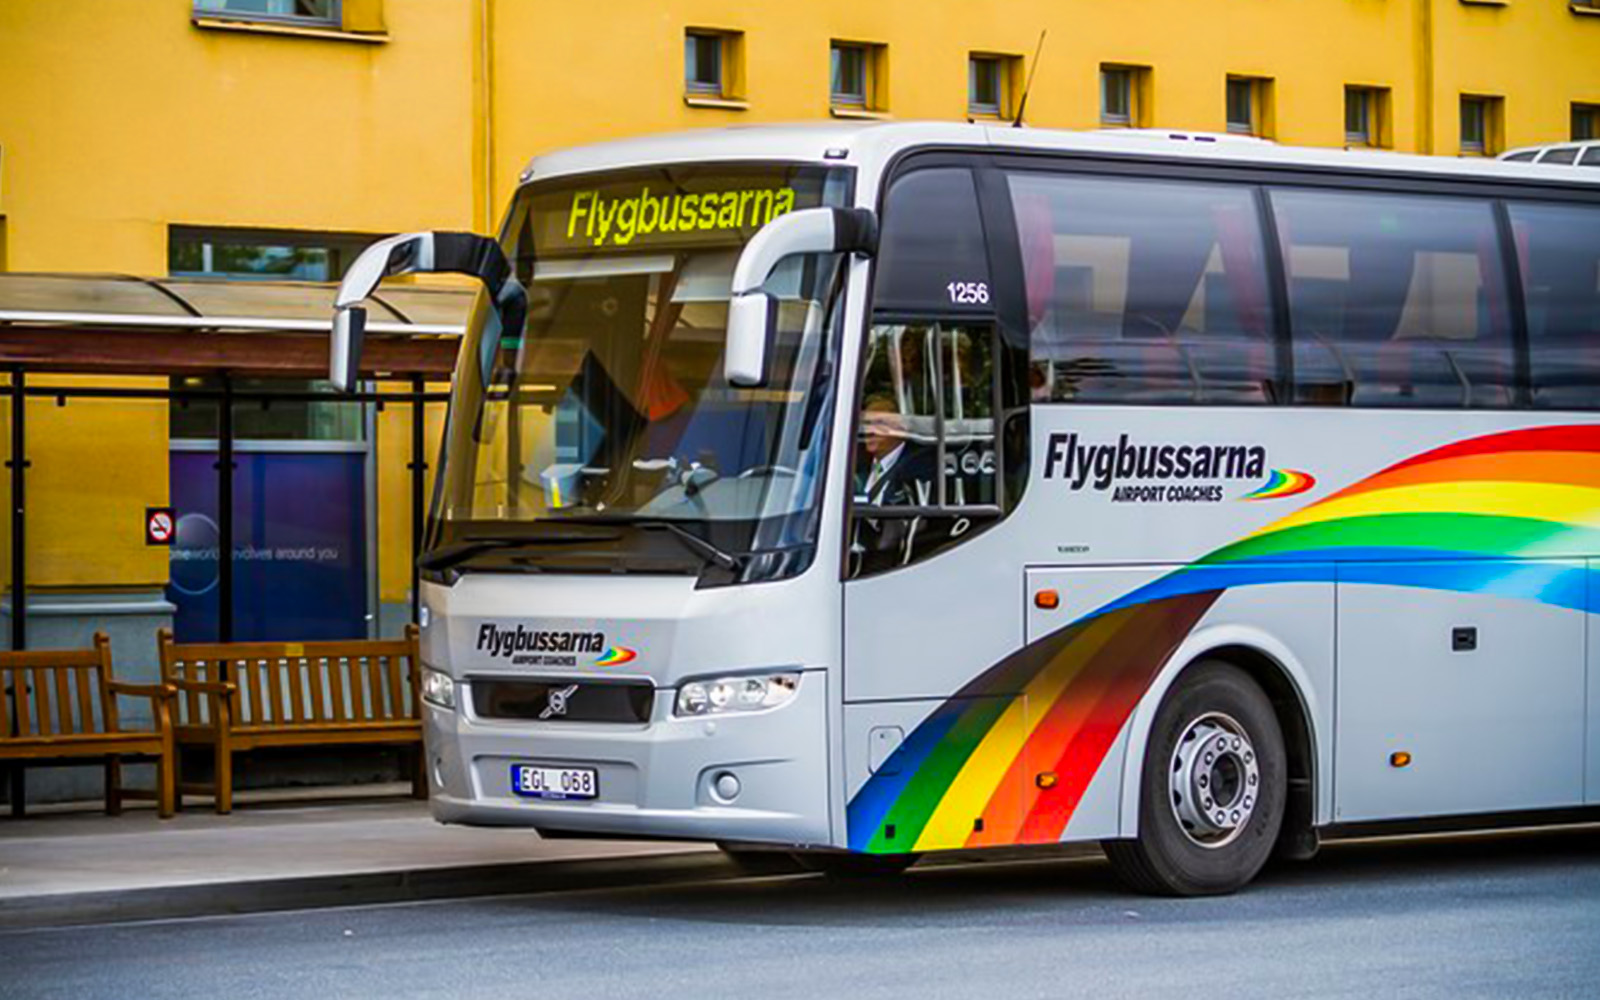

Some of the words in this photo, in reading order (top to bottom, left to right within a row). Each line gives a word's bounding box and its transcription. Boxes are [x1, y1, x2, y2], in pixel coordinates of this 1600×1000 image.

[567, 187, 796, 246] Flygbussarna
[947, 281, 989, 304] 1256
[1043, 432, 1266, 491] Flygbussarna
[1111, 484, 1166, 502] AIRPORT
[1166, 484, 1223, 502] COACHES
[274, 546, 315, 561] around
[317, 547, 338, 564] you
[476, 623, 605, 657] Flygbussarna
[522, 768, 550, 791] EGL
[560, 770, 591, 792] 068
